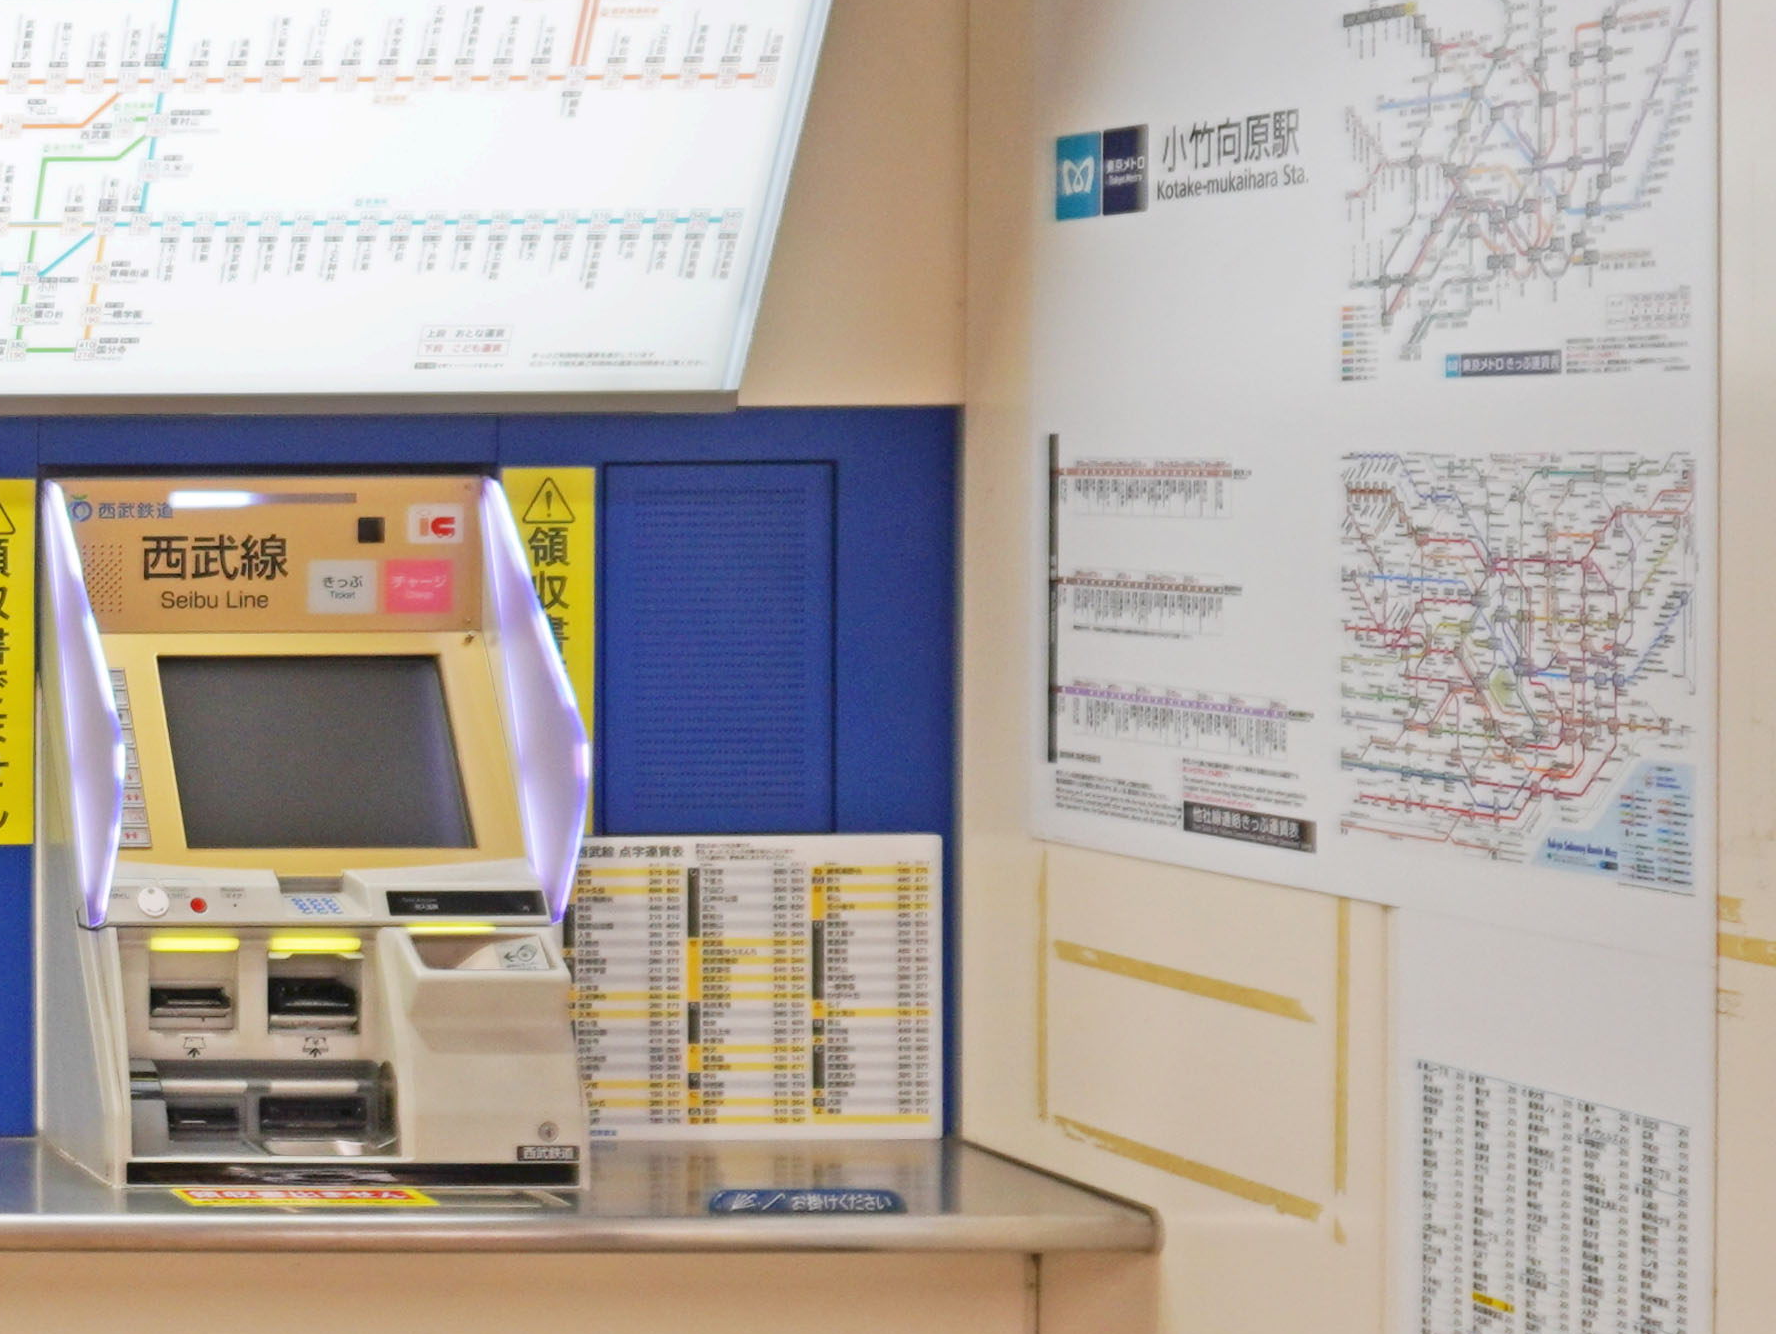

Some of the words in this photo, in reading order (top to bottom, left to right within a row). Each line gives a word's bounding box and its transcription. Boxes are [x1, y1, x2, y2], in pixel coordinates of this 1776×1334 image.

[1161, 109, 1300, 169] 小竹向原駅
[1106, 154, 1146, 172] 東京メトロ
[1157, 166, 1278, 201] Kotake-mukaihara
[1282, 160, 1309, 185] Sta.
[98, 502, 173, 519] 西武鉄道
[142, 534, 288, 581] 西武線
[322, 575, 363, 590] きっぷ
[391, 575, 447, 589] チャージ
[160, 591, 218, 609] Seibu
[226, 591, 268, 609] Line
[330, 591, 356, 600] Ticket
[619, 846, 683, 858] 点字運賃表
[522, 1147, 575, 1161] 西武鉄道
[194, 1189, 406, 1201] 領収書出ません
[790, 1193, 893, 1213] お掛けください
